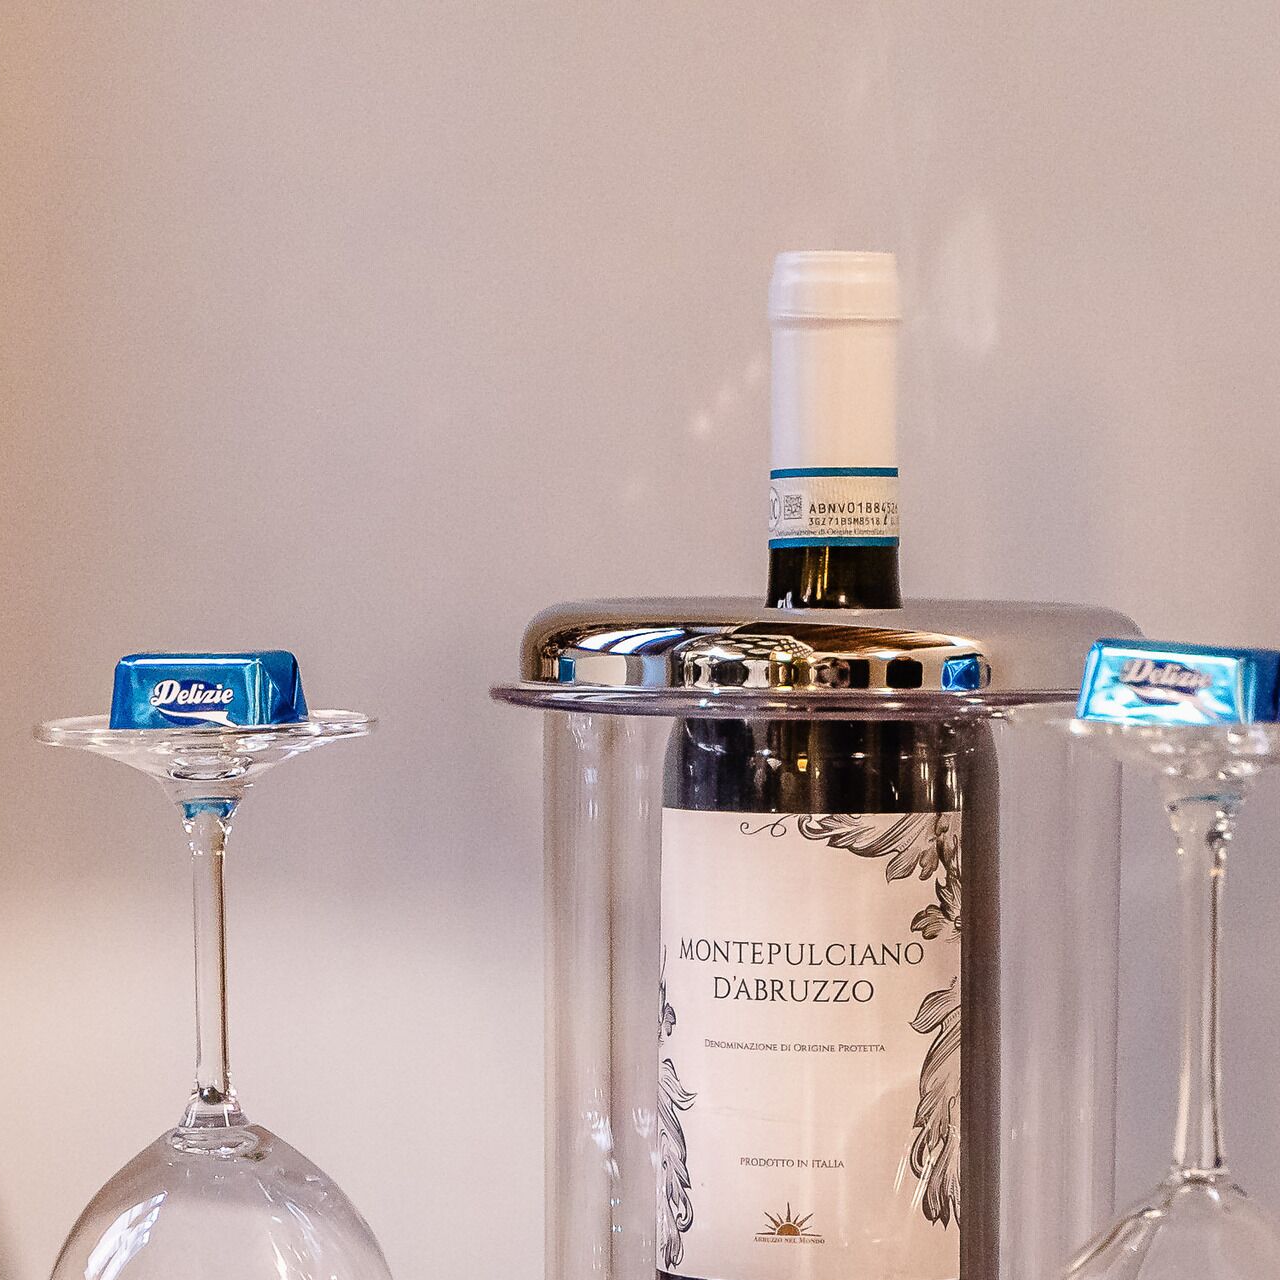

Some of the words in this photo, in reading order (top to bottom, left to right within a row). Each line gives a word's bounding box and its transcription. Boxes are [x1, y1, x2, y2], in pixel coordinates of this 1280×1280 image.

[150, 680, 234, 706] Delizie
[679, 936, 925, 967] MONTEPULCIANO
[713, 975, 875, 1003] D'ABRUZZO
[740, 1157, 795, 1168] PRODOTTO
[797, 1159, 808, 1168] IN
[811, 1159, 845, 1169] ITALIA
